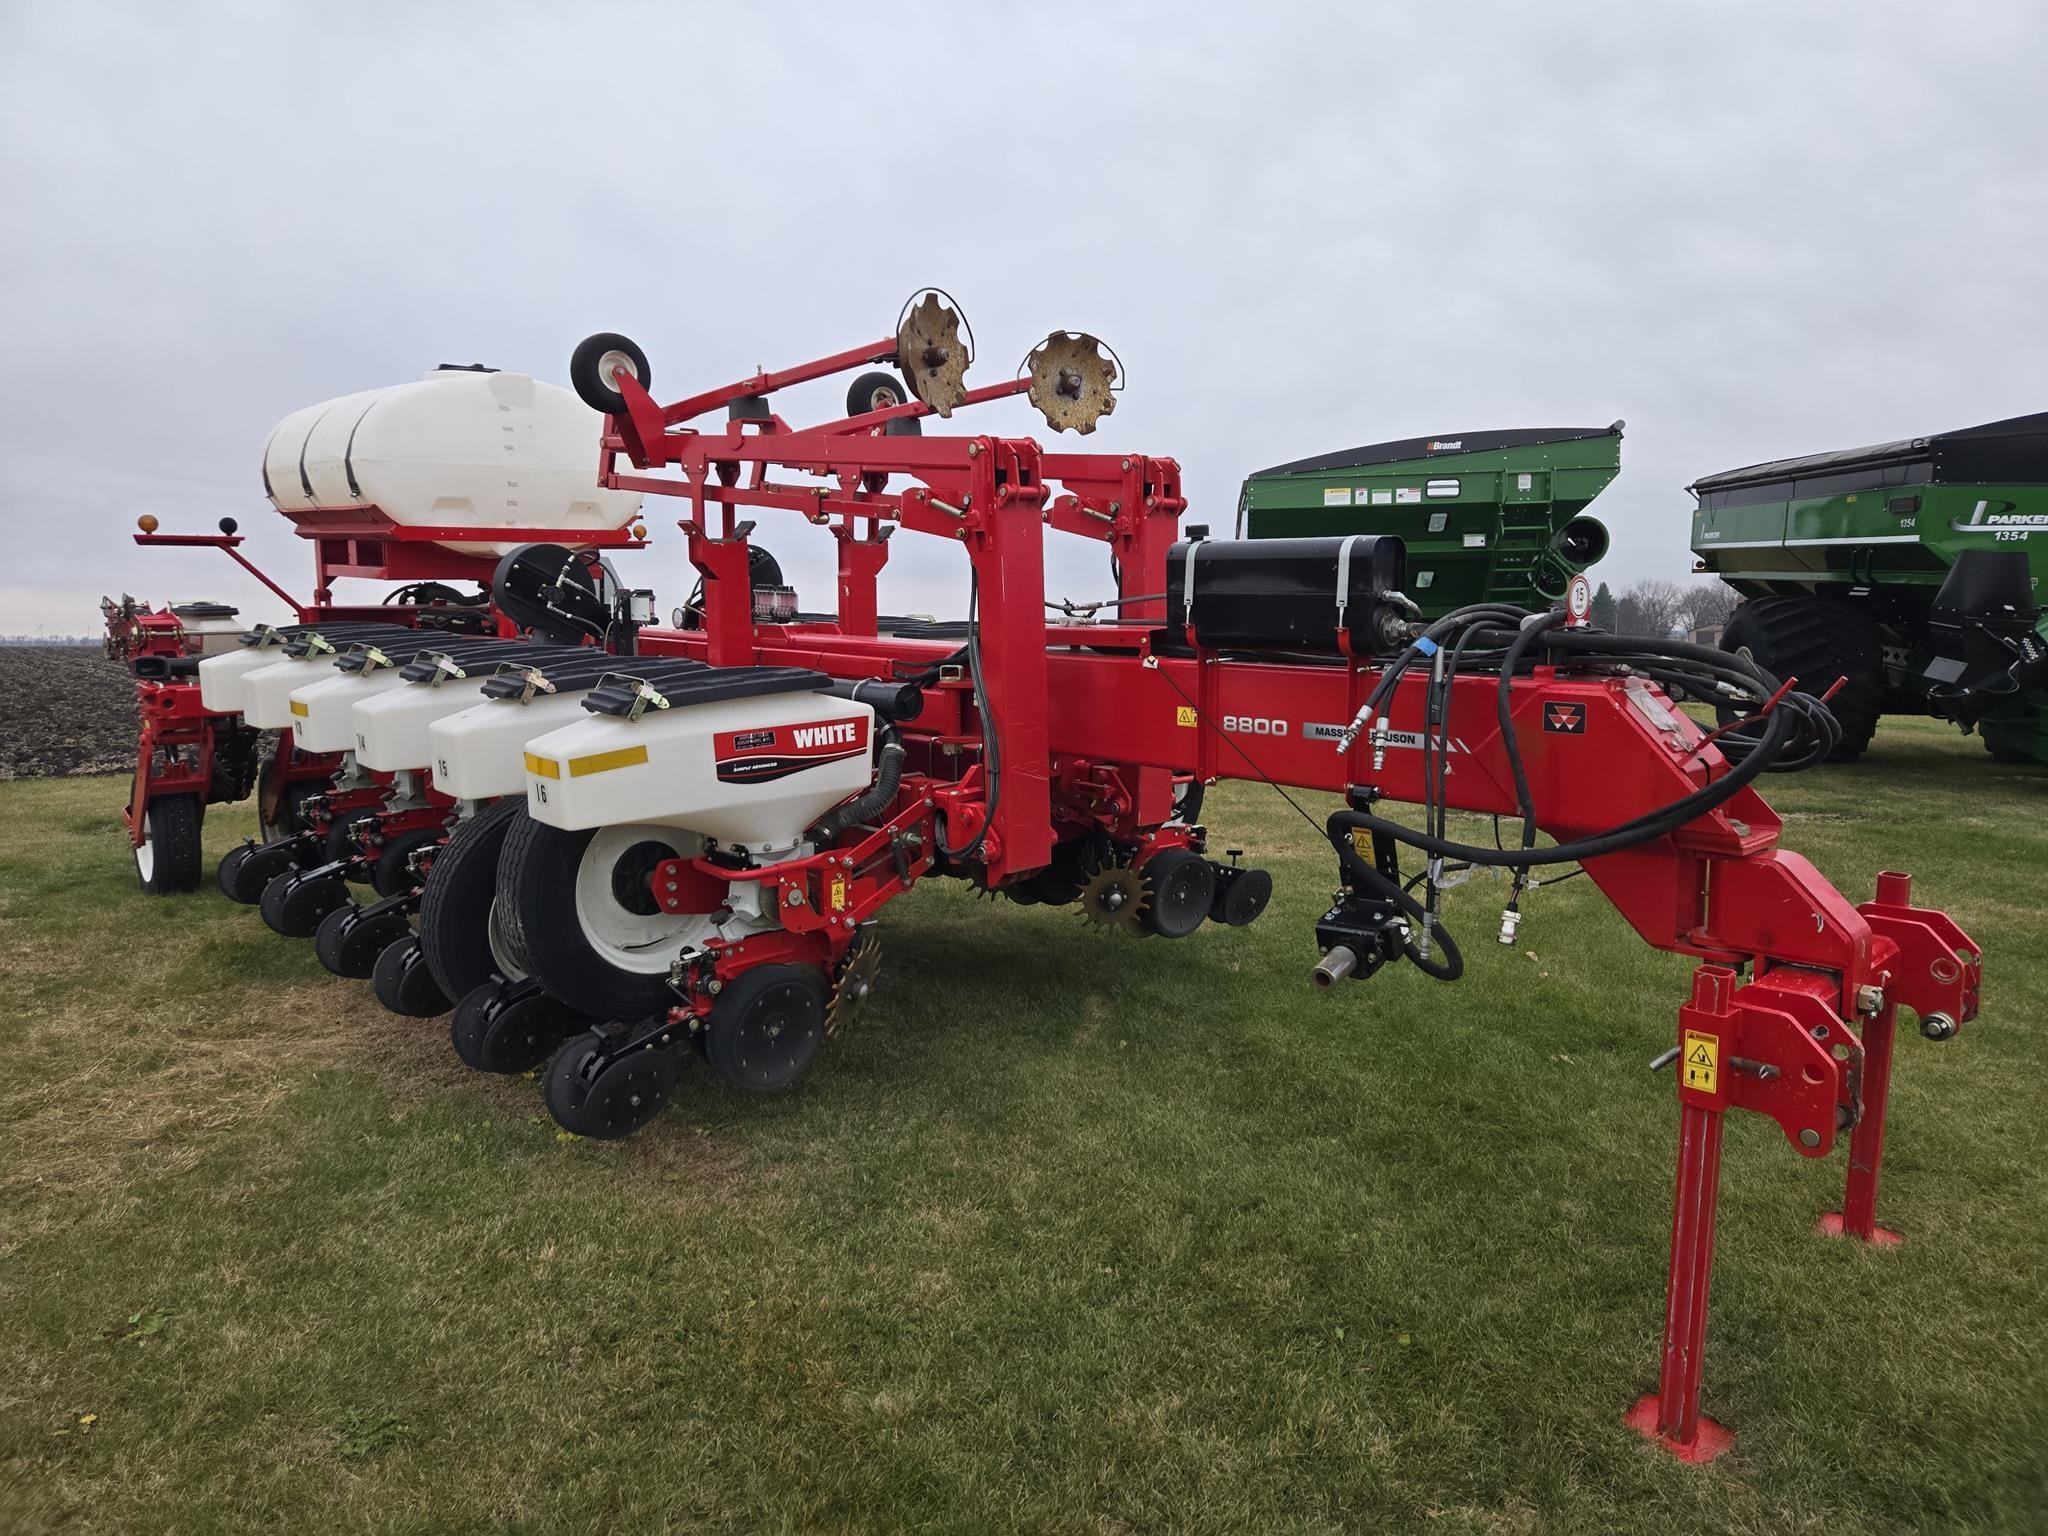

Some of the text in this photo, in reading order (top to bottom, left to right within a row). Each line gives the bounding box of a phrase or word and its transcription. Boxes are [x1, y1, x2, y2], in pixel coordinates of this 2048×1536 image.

[1433, 441, 1462, 450] Brandt
[1899, 518, 1916, 529] 1354
[1986, 514, 2048, 525] PARKE
[1994, 531, 2029, 541] 1354
[1575, 587, 1585, 601] 15
[1223, 715, 1288, 736] 8800
[793, 722, 857, 749] WHITE
[438, 759, 448, 777] 15
[535, 783, 547, 804] 16
